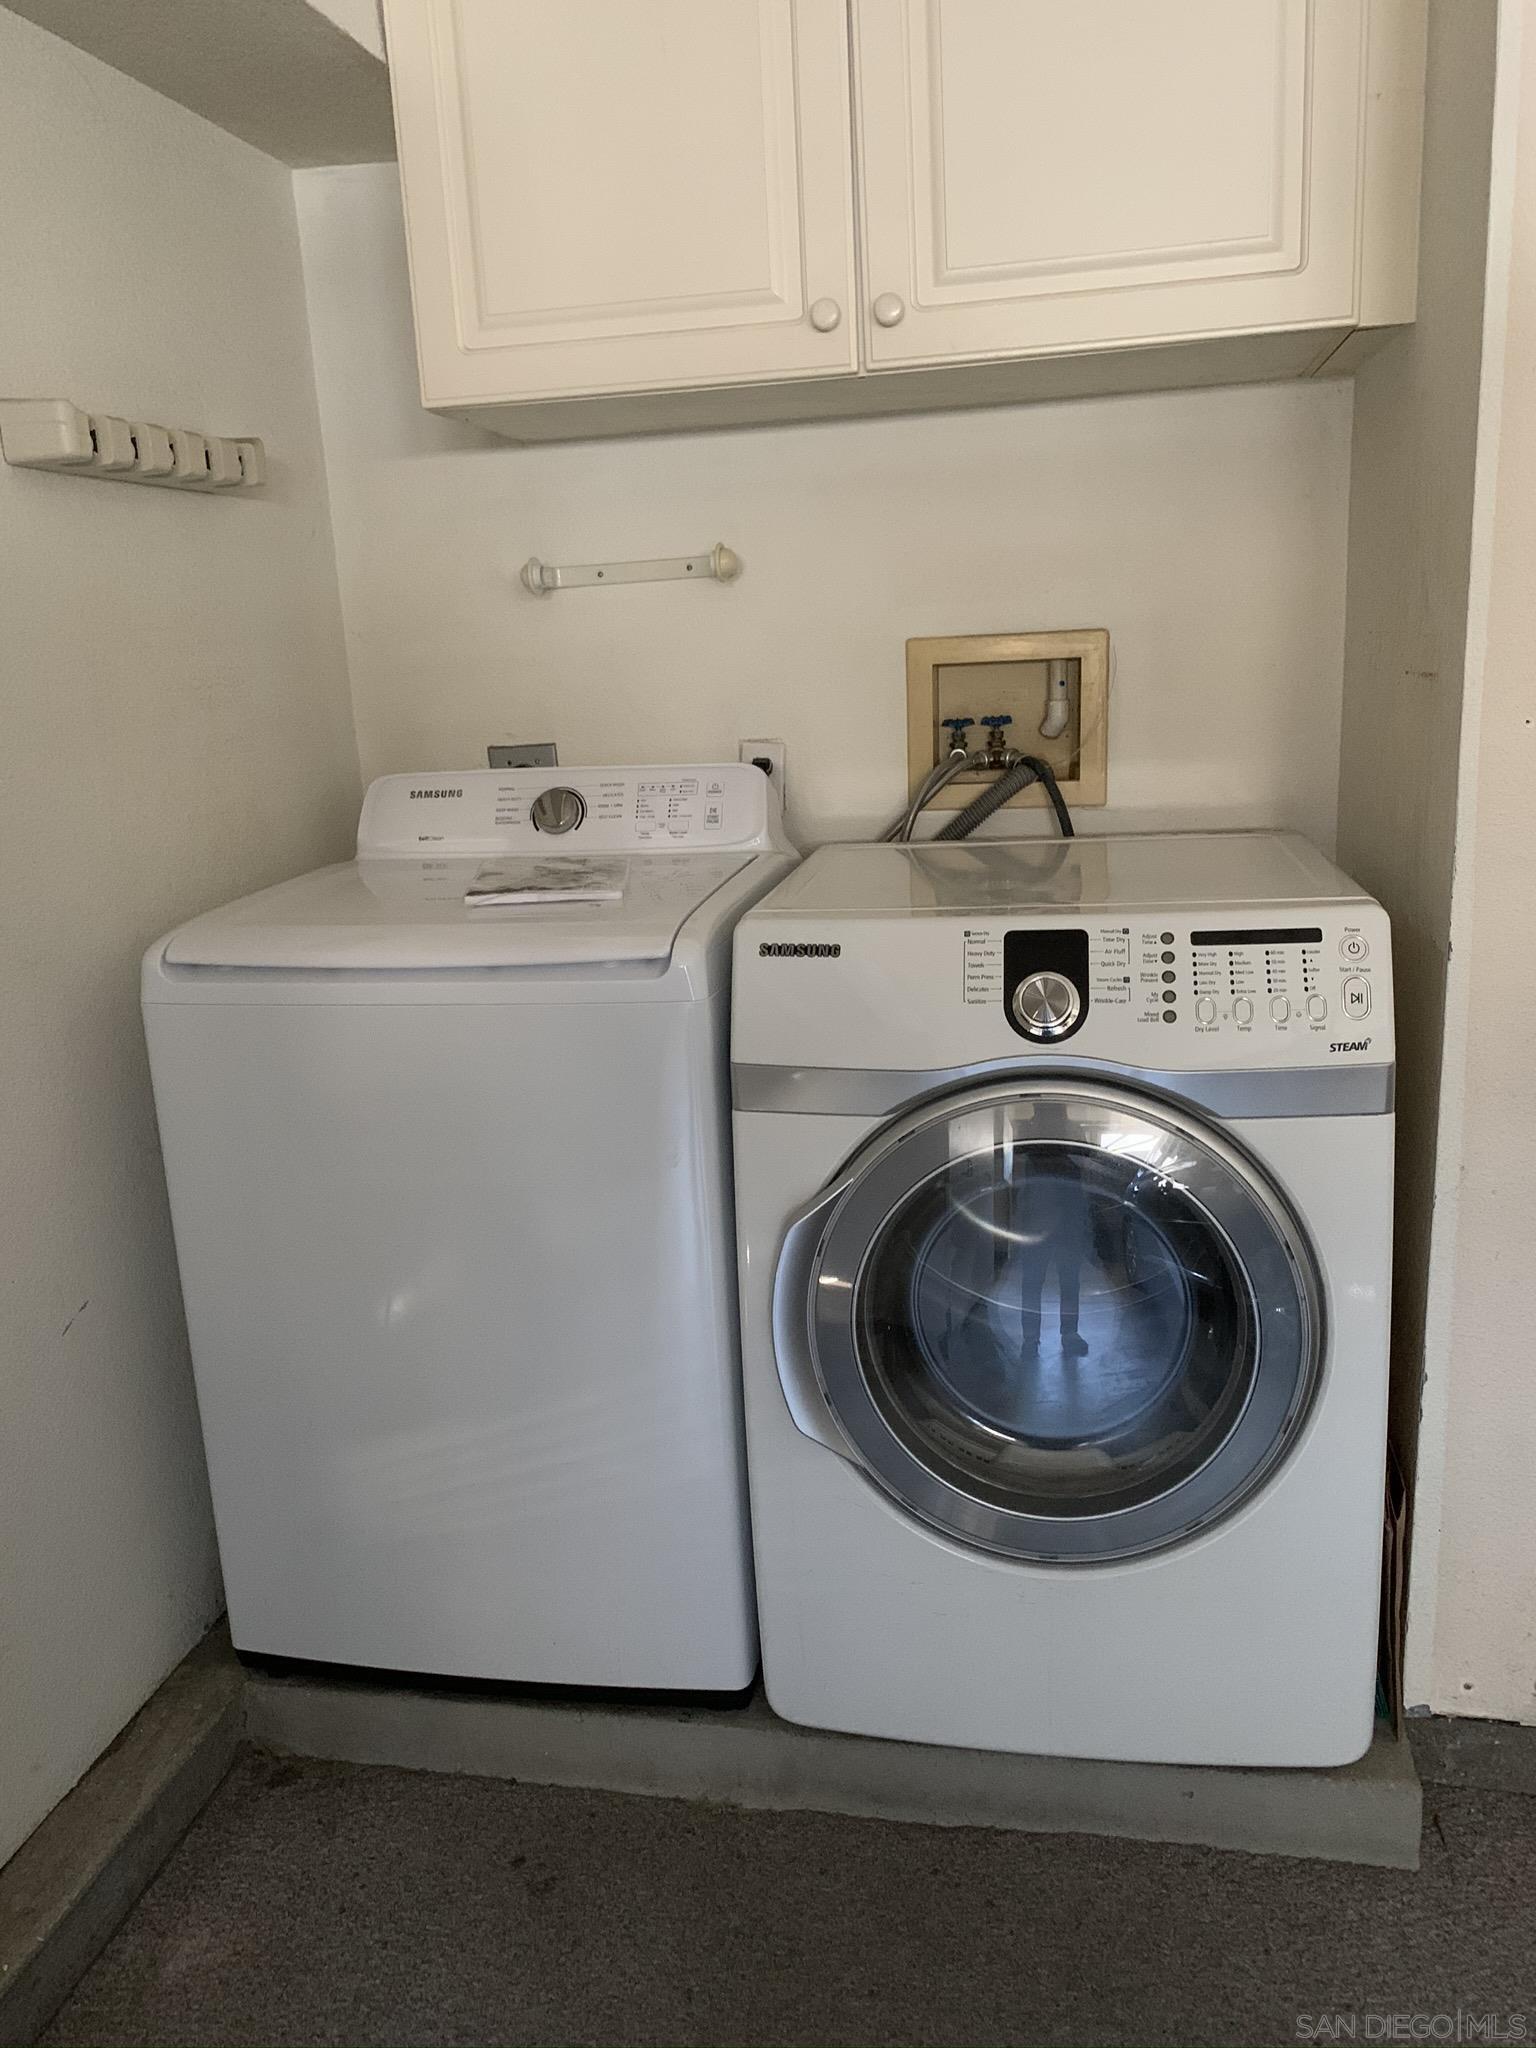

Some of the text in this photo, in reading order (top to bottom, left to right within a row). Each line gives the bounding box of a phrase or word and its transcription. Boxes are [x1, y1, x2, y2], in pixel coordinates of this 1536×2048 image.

[410, 789, 463, 799] SAMSUNG
[759, 942, 841, 958] SAMSUNG
[1330, 1042, 1368, 1052] STEAM
